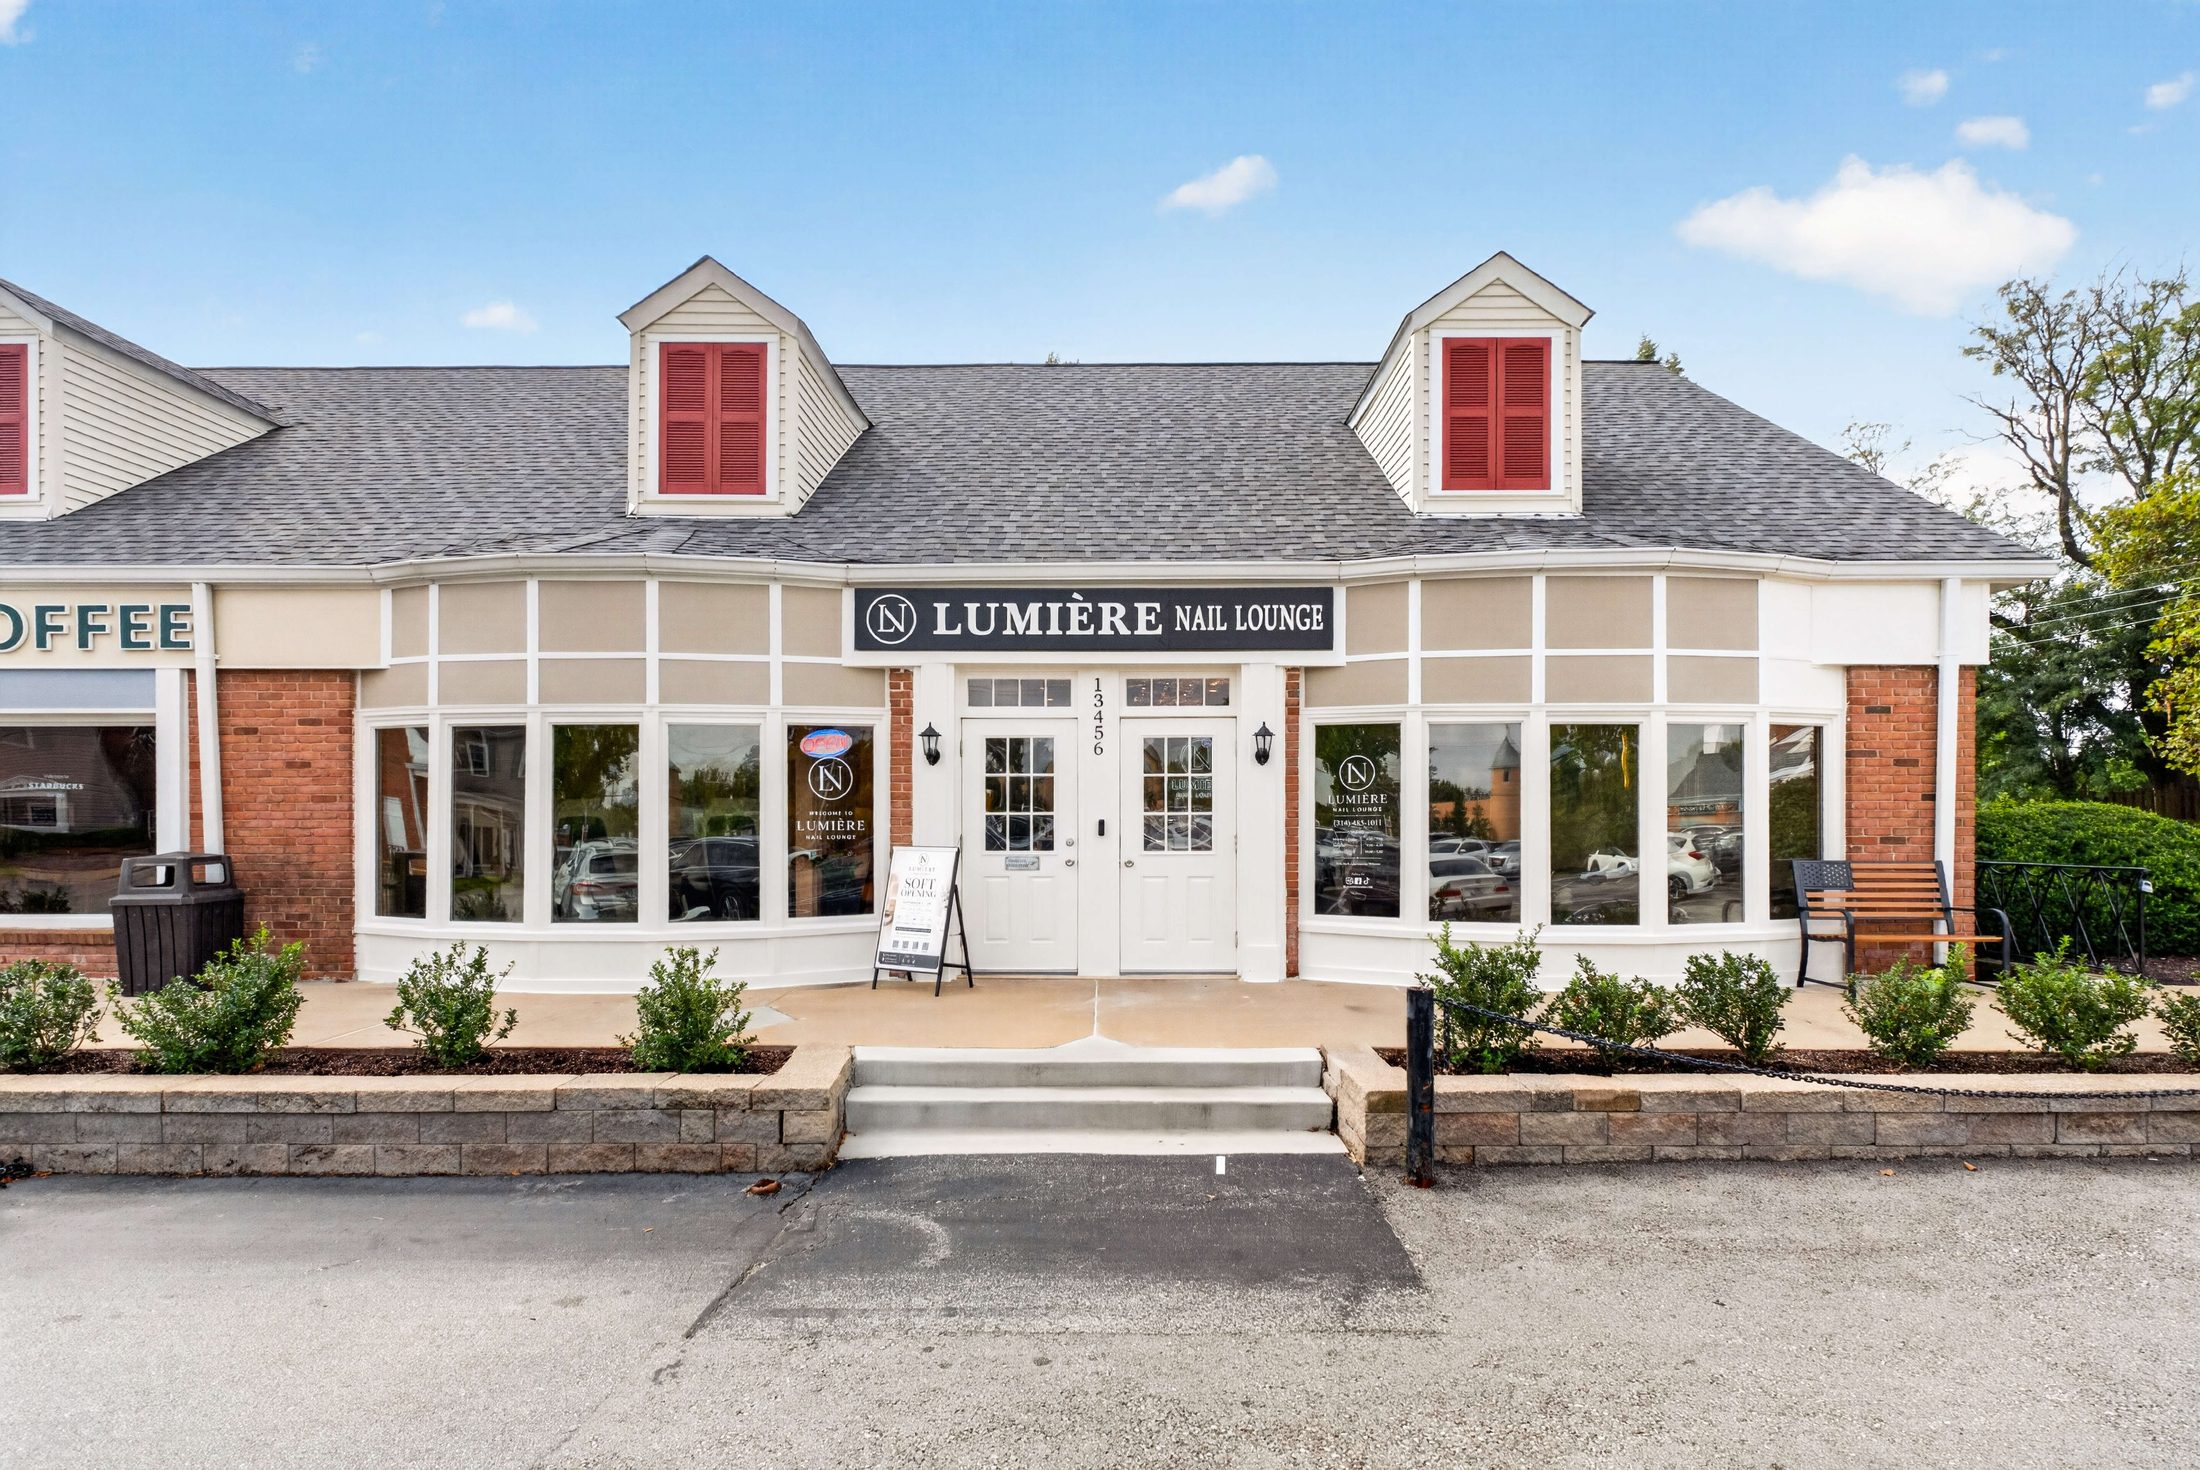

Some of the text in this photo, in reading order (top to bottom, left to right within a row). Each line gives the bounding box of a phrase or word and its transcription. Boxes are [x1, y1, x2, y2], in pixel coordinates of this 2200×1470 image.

[932, 591, 1325, 636] LUMIÈRE NAIL LOUNGE
[28, 782, 85, 790] STARBUCKS
[1328, 791, 1388, 805] LUMIÈRE
[796, 818, 866, 831] LUMIÈRE
[904, 877, 937, 890] SOFT
[900, 889, 937, 898] OPENING
